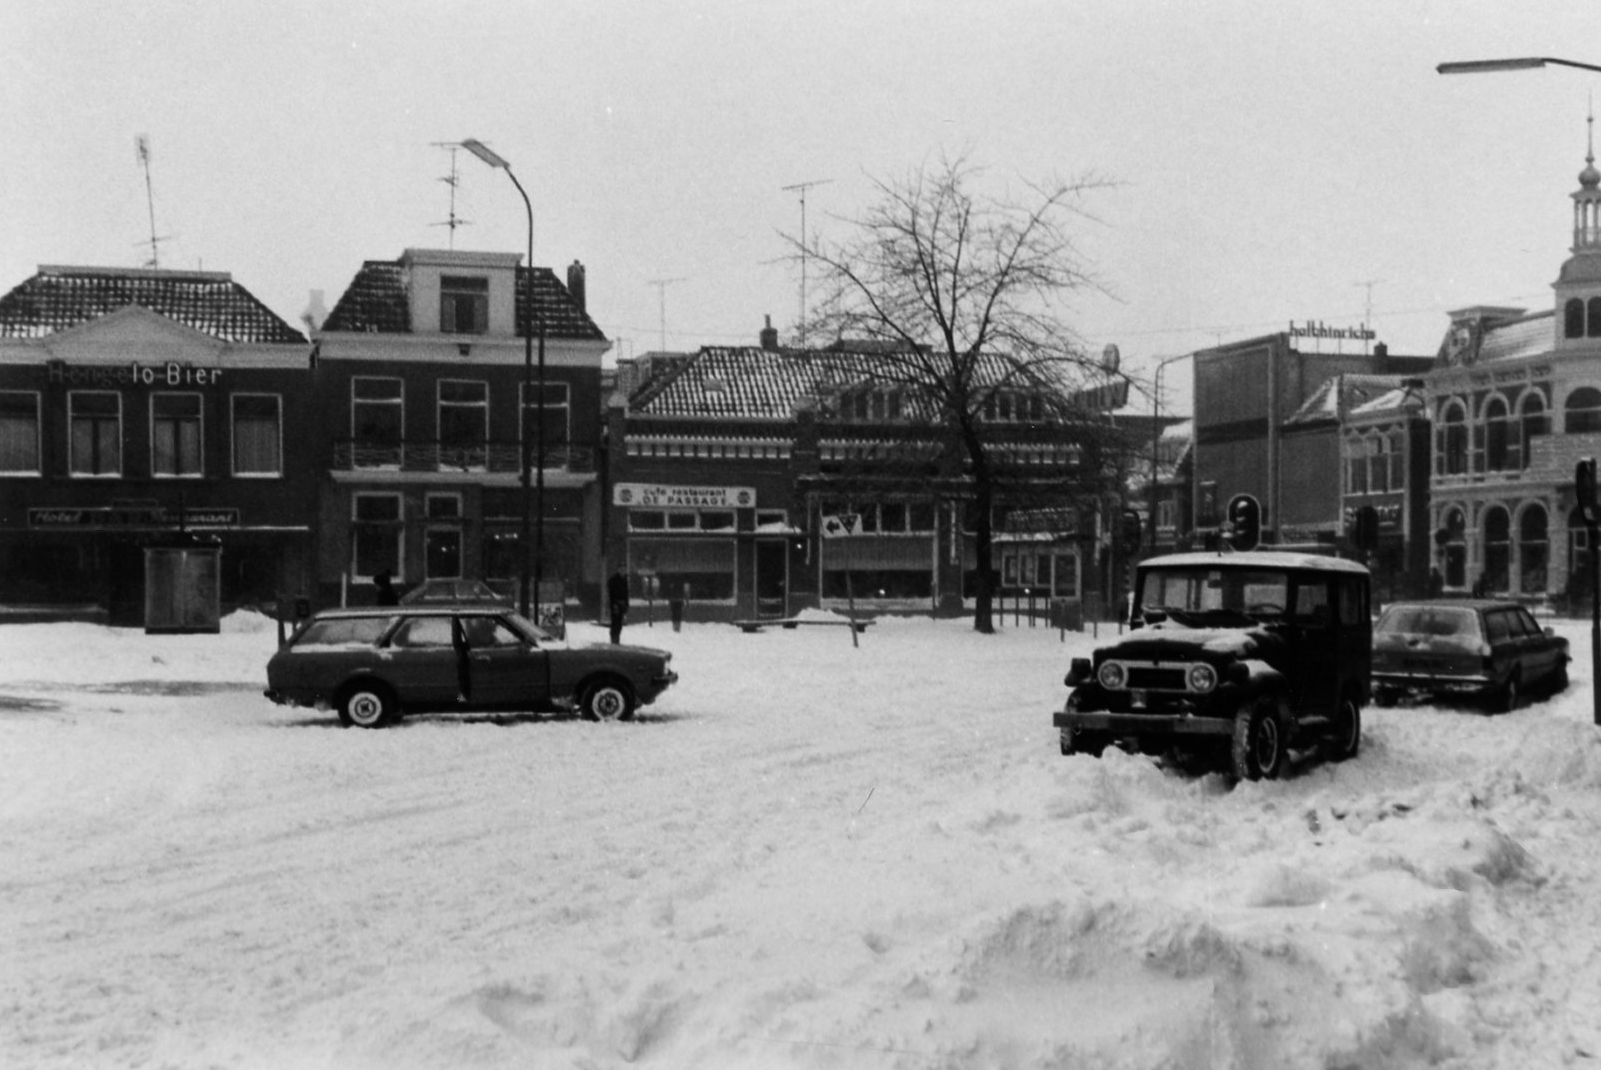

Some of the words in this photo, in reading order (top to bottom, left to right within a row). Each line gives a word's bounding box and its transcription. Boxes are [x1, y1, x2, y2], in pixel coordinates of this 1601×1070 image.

[48, 361, 155, 387] Hengelo
[166, 361, 223, 386] Bier
[672, 487, 726, 497] restaurant
[642, 495, 660, 505] DE
[667, 496, 727, 506] PASSAGE
[35, 510, 82, 523] Hotel
